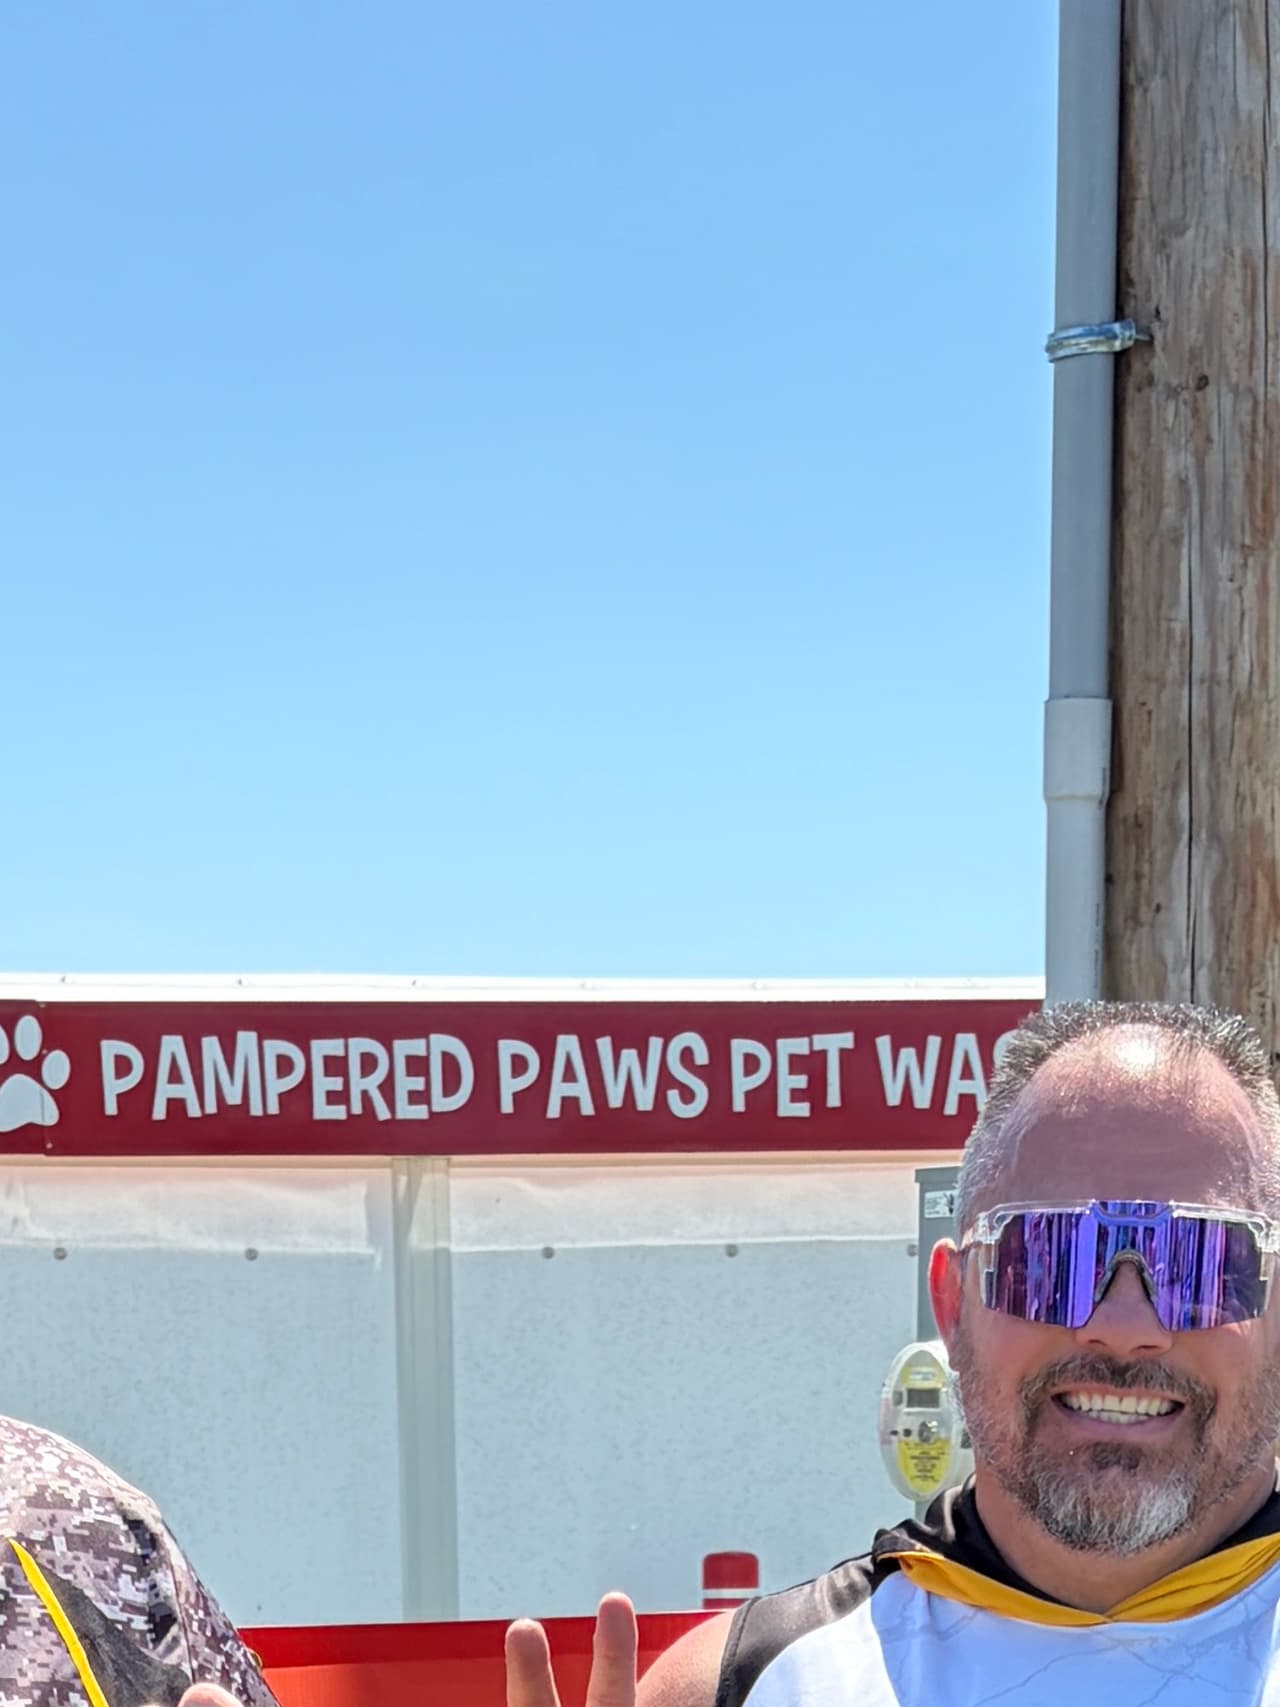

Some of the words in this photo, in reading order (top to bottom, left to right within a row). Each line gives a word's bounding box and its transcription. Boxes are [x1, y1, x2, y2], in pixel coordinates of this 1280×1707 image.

[100, 1030, 475, 1121] PAMPERED
[497, 1031, 710, 1119] PAWS
[730, 1031, 855, 1118] PET
[875, 1029, 1021, 1117] WA
